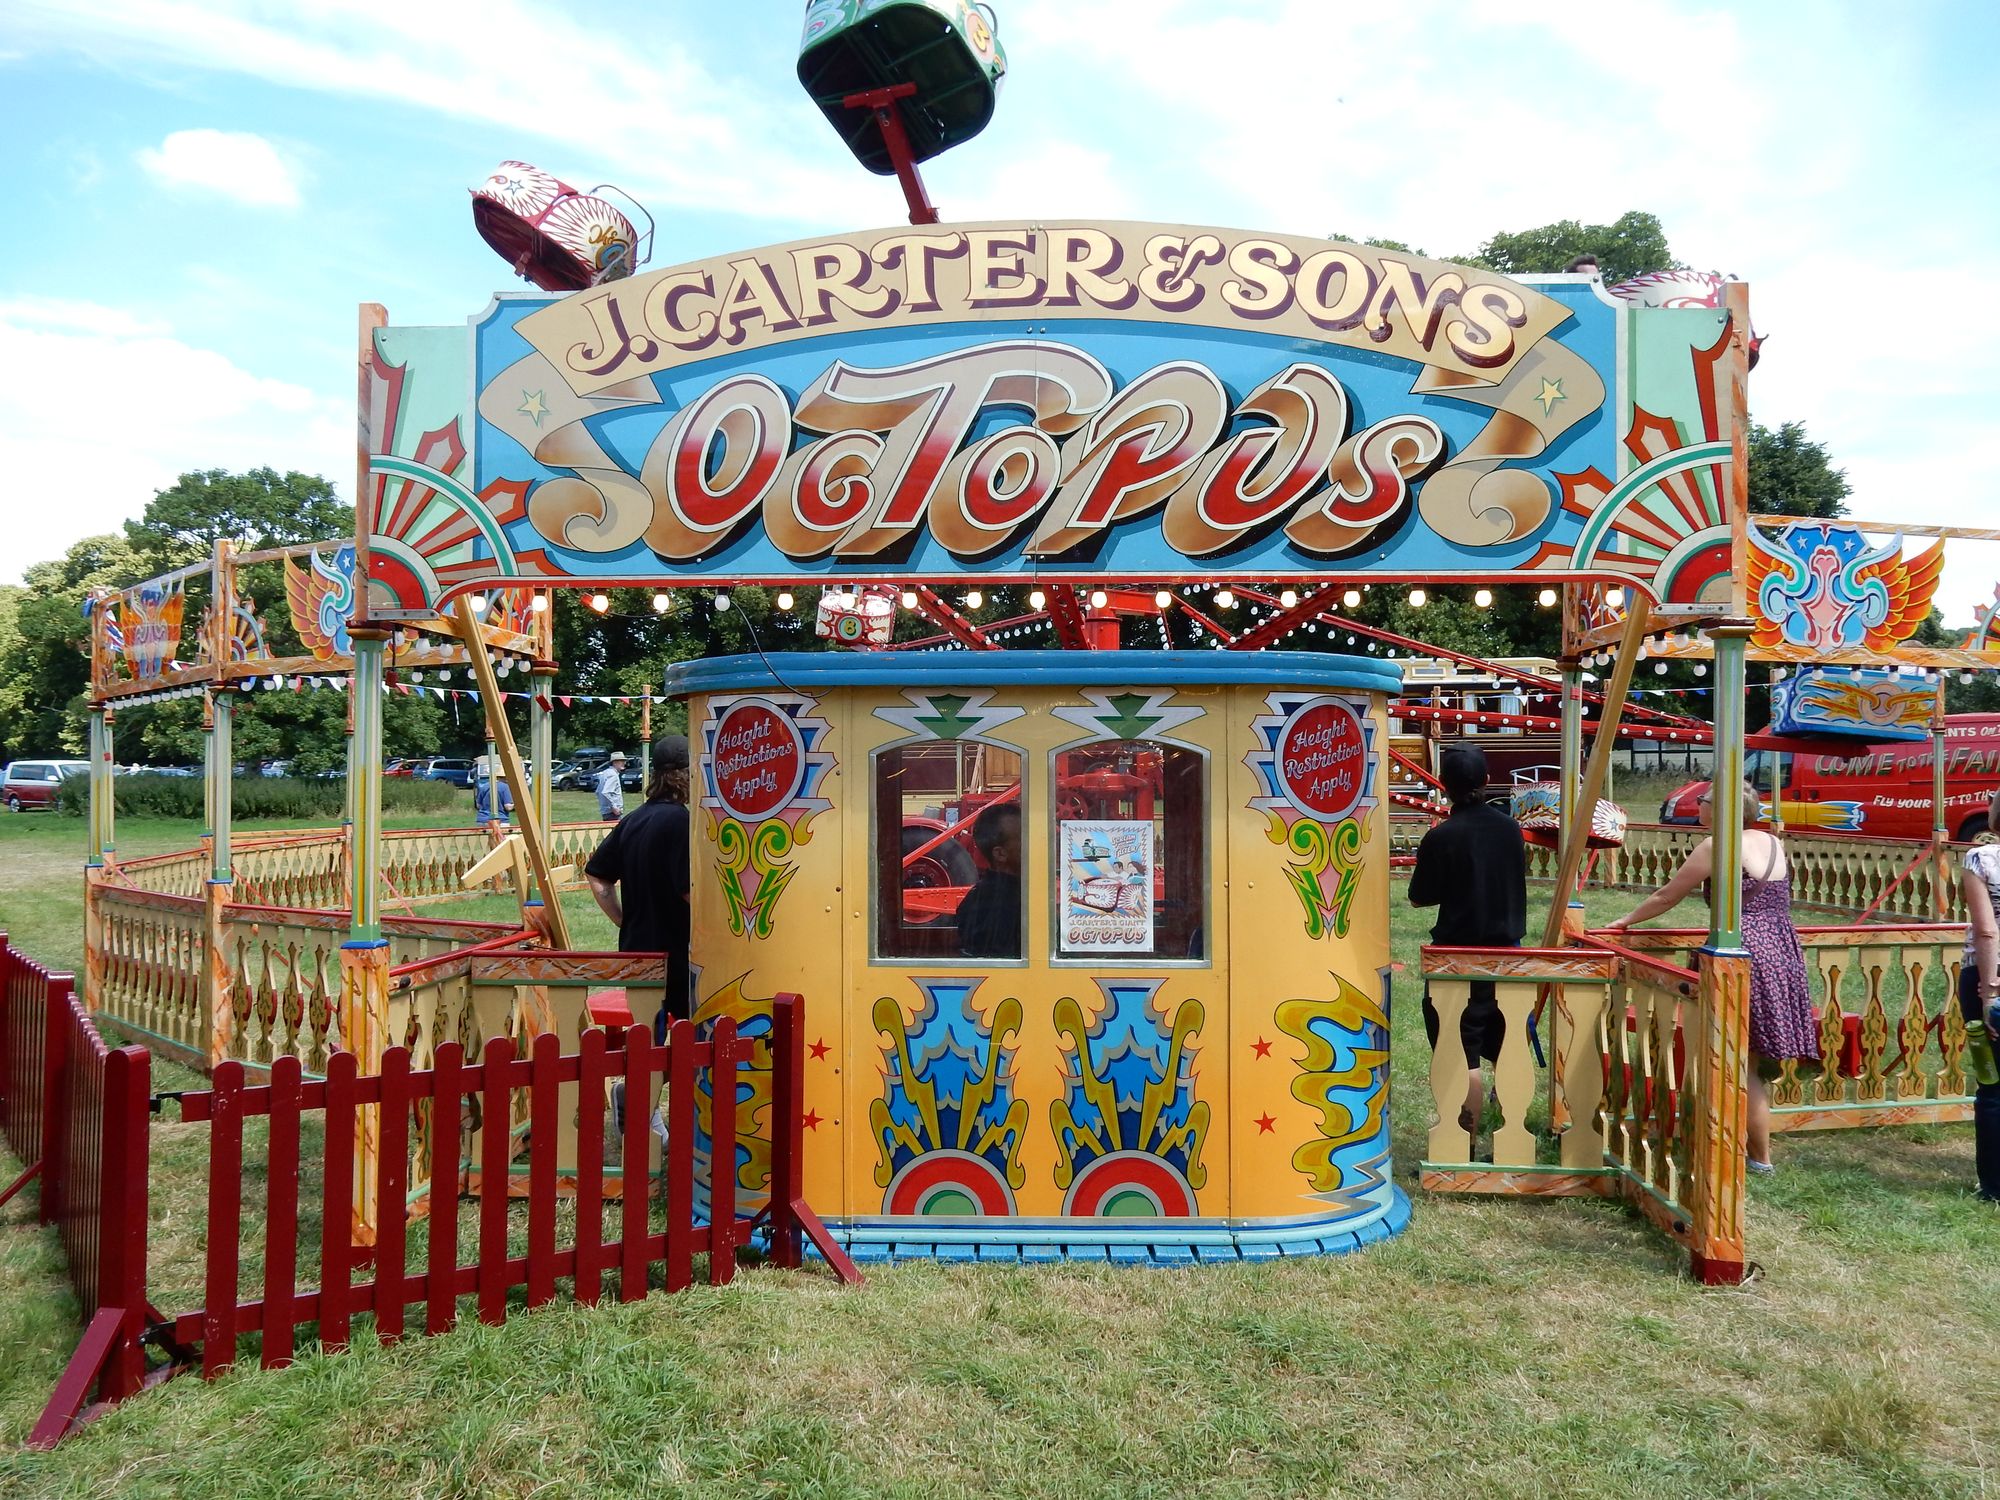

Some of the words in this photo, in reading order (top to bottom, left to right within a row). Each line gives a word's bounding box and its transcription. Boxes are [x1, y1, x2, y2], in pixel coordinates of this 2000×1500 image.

[1138, 235, 1225, 312] &
[1221, 240, 1527, 367] SONS
[844, 618, 857, 637] 8
[720, 717, 772, 753] Height
[1292, 717, 1347, 753] Height
[716, 742, 793, 780] Restrictions
[1285, 742, 1361, 779] Restrictions
[1947, 747, 2000, 774] FAI
[730, 768, 777, 800] Apply
[1306, 768, 1352, 800] Apply
[1068, 927, 1147, 944] OCTOPUS
